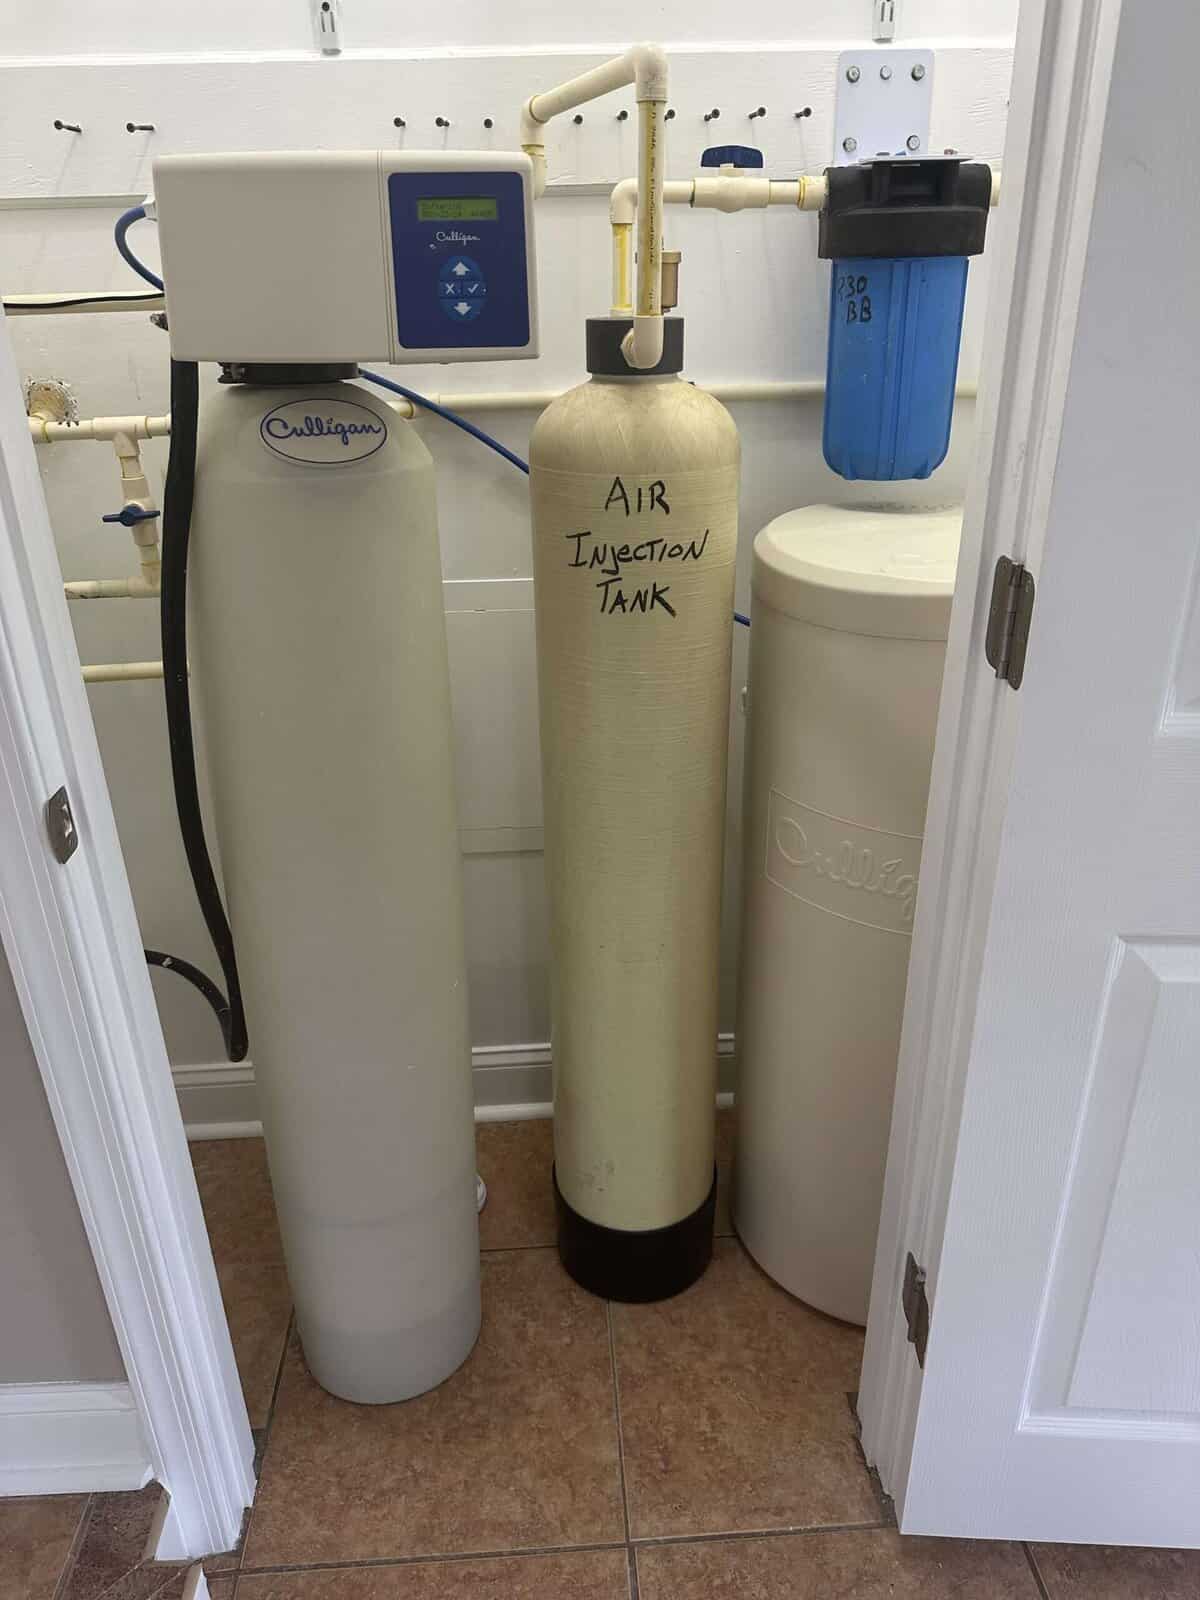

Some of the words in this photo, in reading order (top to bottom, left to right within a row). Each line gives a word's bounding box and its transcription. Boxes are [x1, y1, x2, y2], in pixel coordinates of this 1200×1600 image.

[435, 231, 481, 246] Culligan
[846, 296, 873, 325] BB
[266, 416, 381, 445] Culligan
[604, 476, 671, 517] AIR
[596, 577, 677, 618] TANK
[775, 816, 918, 921] Cullig
